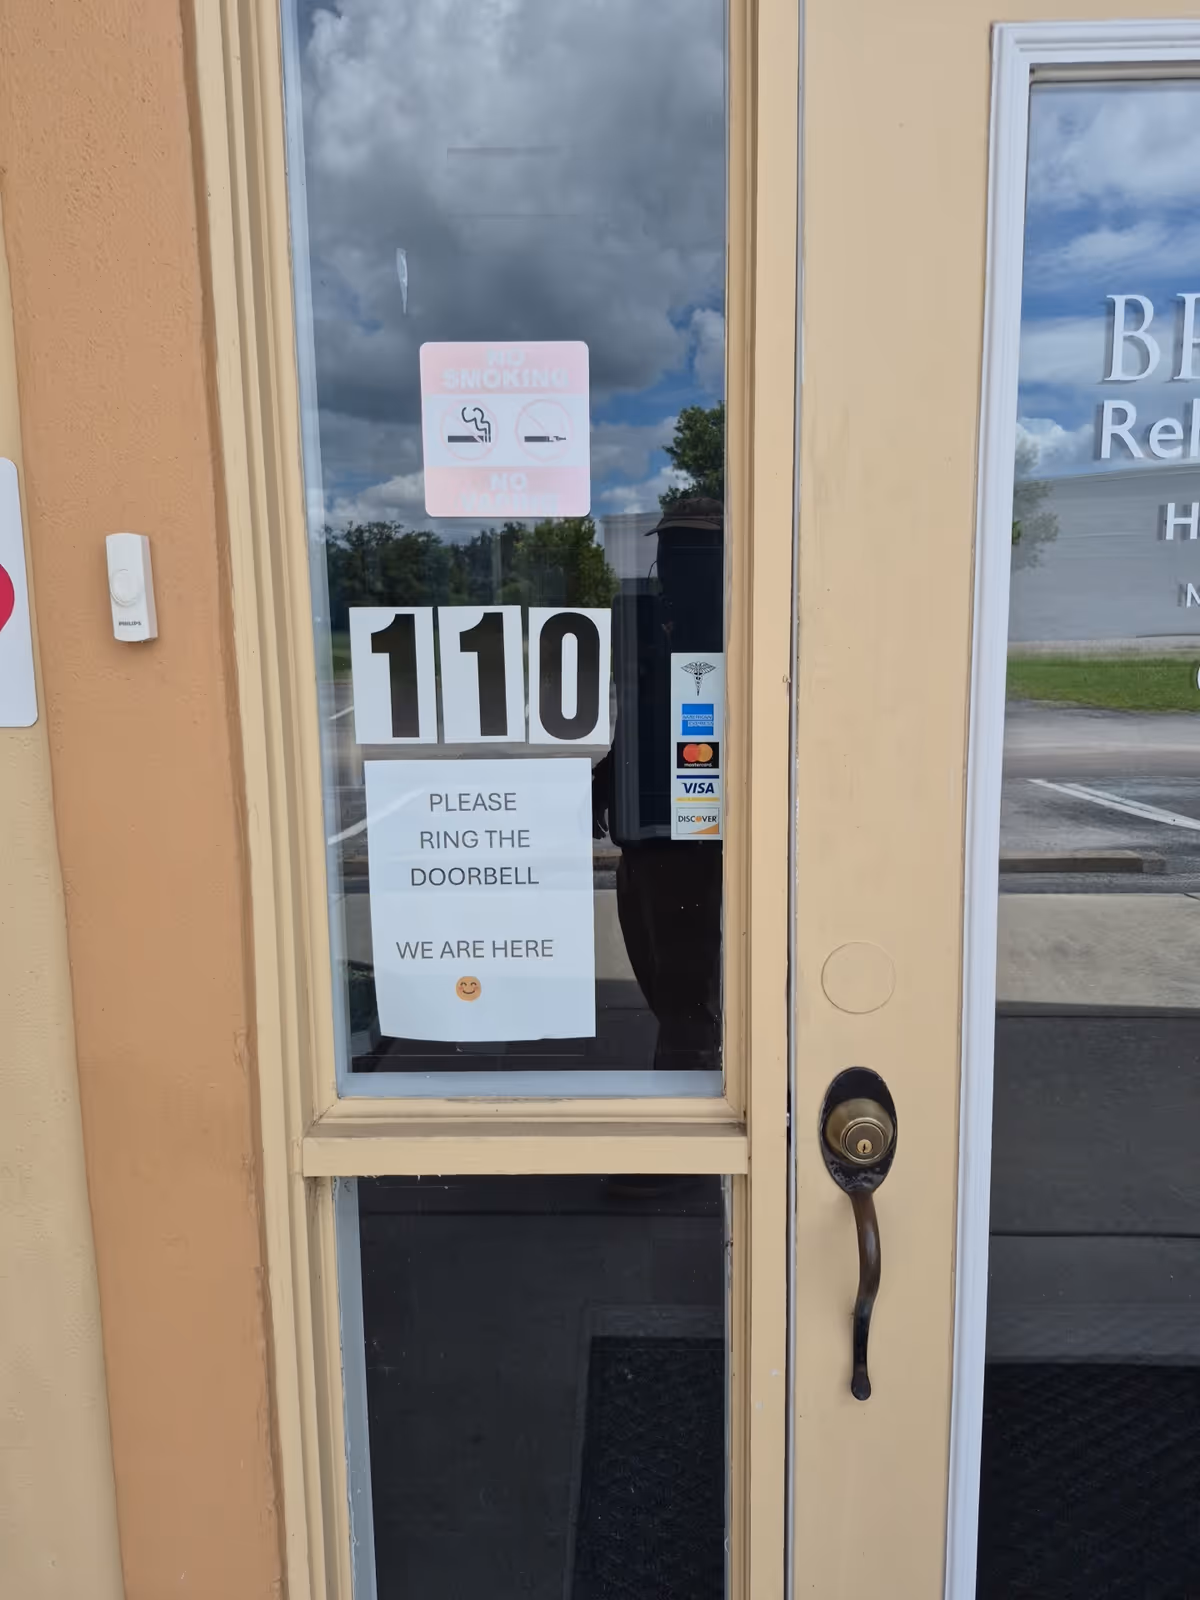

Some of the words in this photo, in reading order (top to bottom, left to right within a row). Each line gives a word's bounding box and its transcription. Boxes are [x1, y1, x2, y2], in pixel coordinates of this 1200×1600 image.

[487, 348, 526, 367] NO
[442, 368, 570, 389] SMOKING
[489, 472, 527, 491] NO
[371, 612, 600, 740] 110
[682, 782, 715, 794] VISA
[430, 792, 517, 812] PLEASE
[677, 815, 717, 823] DISCOVER
[420, 830, 479, 849] RING
[484, 829, 531, 849] THE
[410, 866, 540, 886] DOORBELL
[396, 941, 434, 959] WE
[440, 940, 485, 959] ARE
[492, 939, 554, 958] HERE
